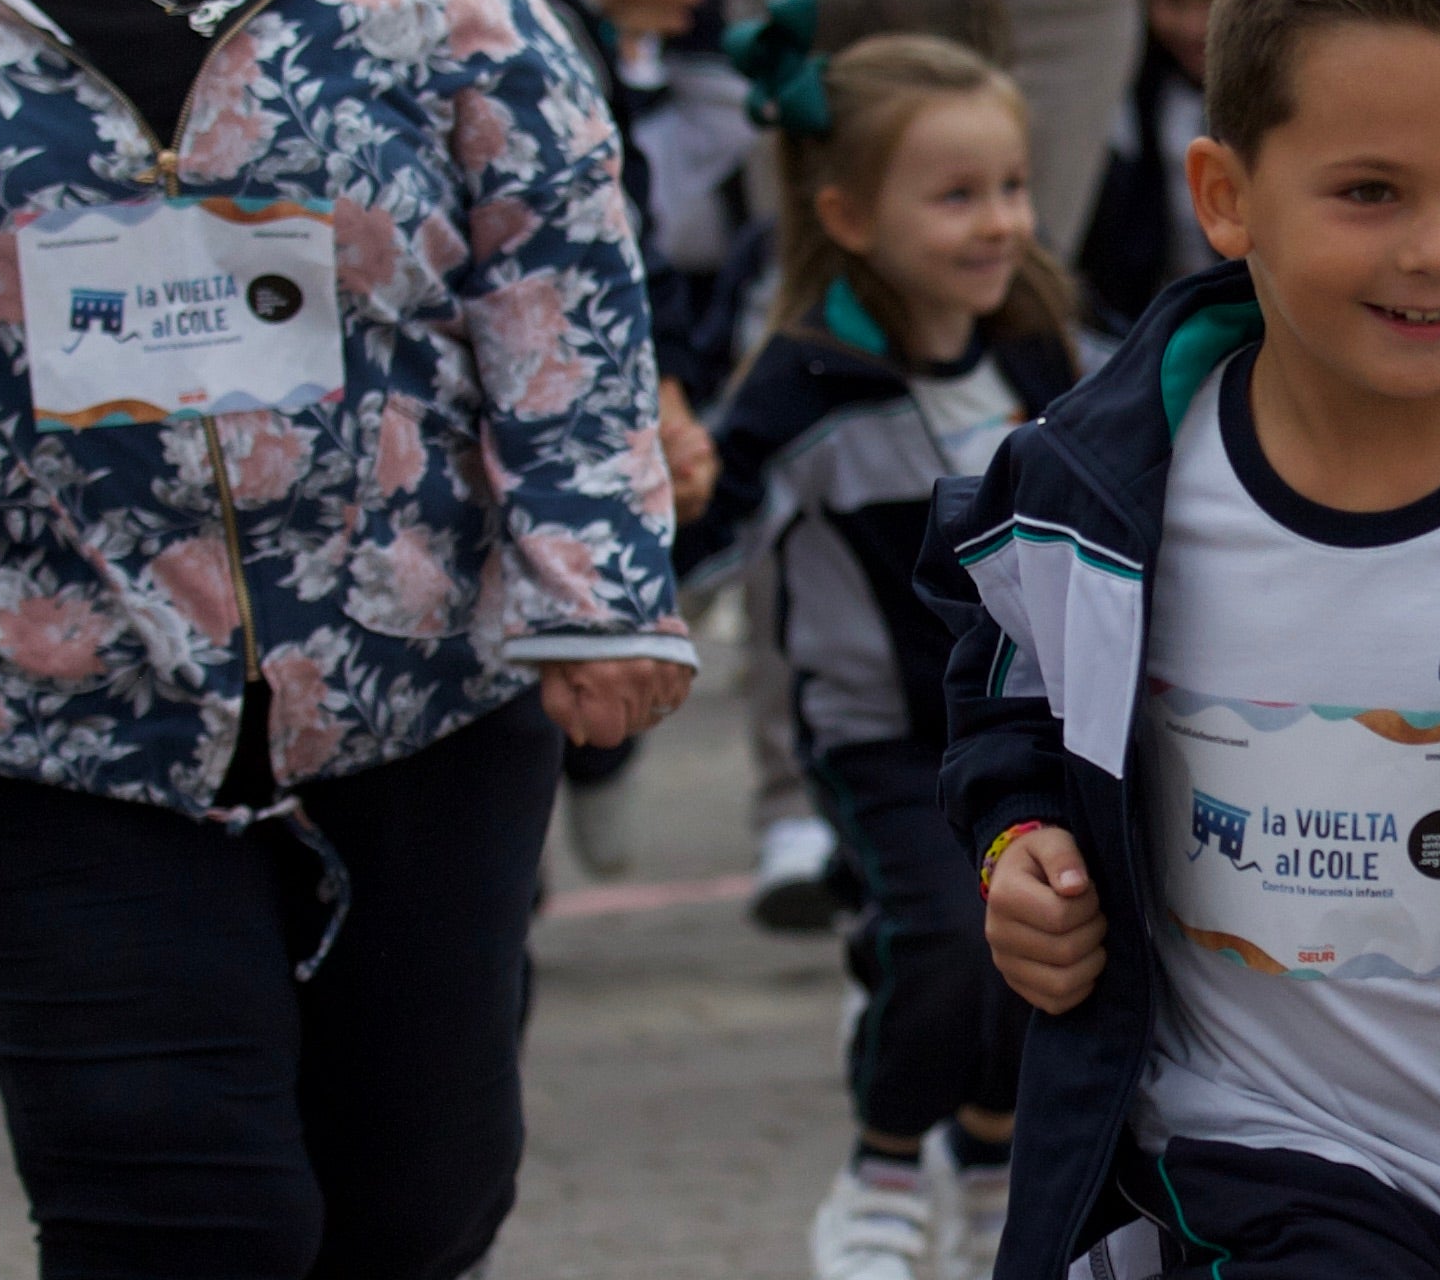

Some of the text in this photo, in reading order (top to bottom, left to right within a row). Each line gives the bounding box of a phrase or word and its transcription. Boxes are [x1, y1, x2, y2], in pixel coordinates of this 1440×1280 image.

[136, 284, 158, 308] la
[162, 274, 237, 305] VUELTA
[152, 308, 229, 338] al COLE
[1262, 805, 1398, 843] la VUELTA
[1276, 849, 1379, 881] al COLE
[1262, 880, 1394, 898] Contra la leucemia infantil
[1298, 951, 1335, 963] SEUR
